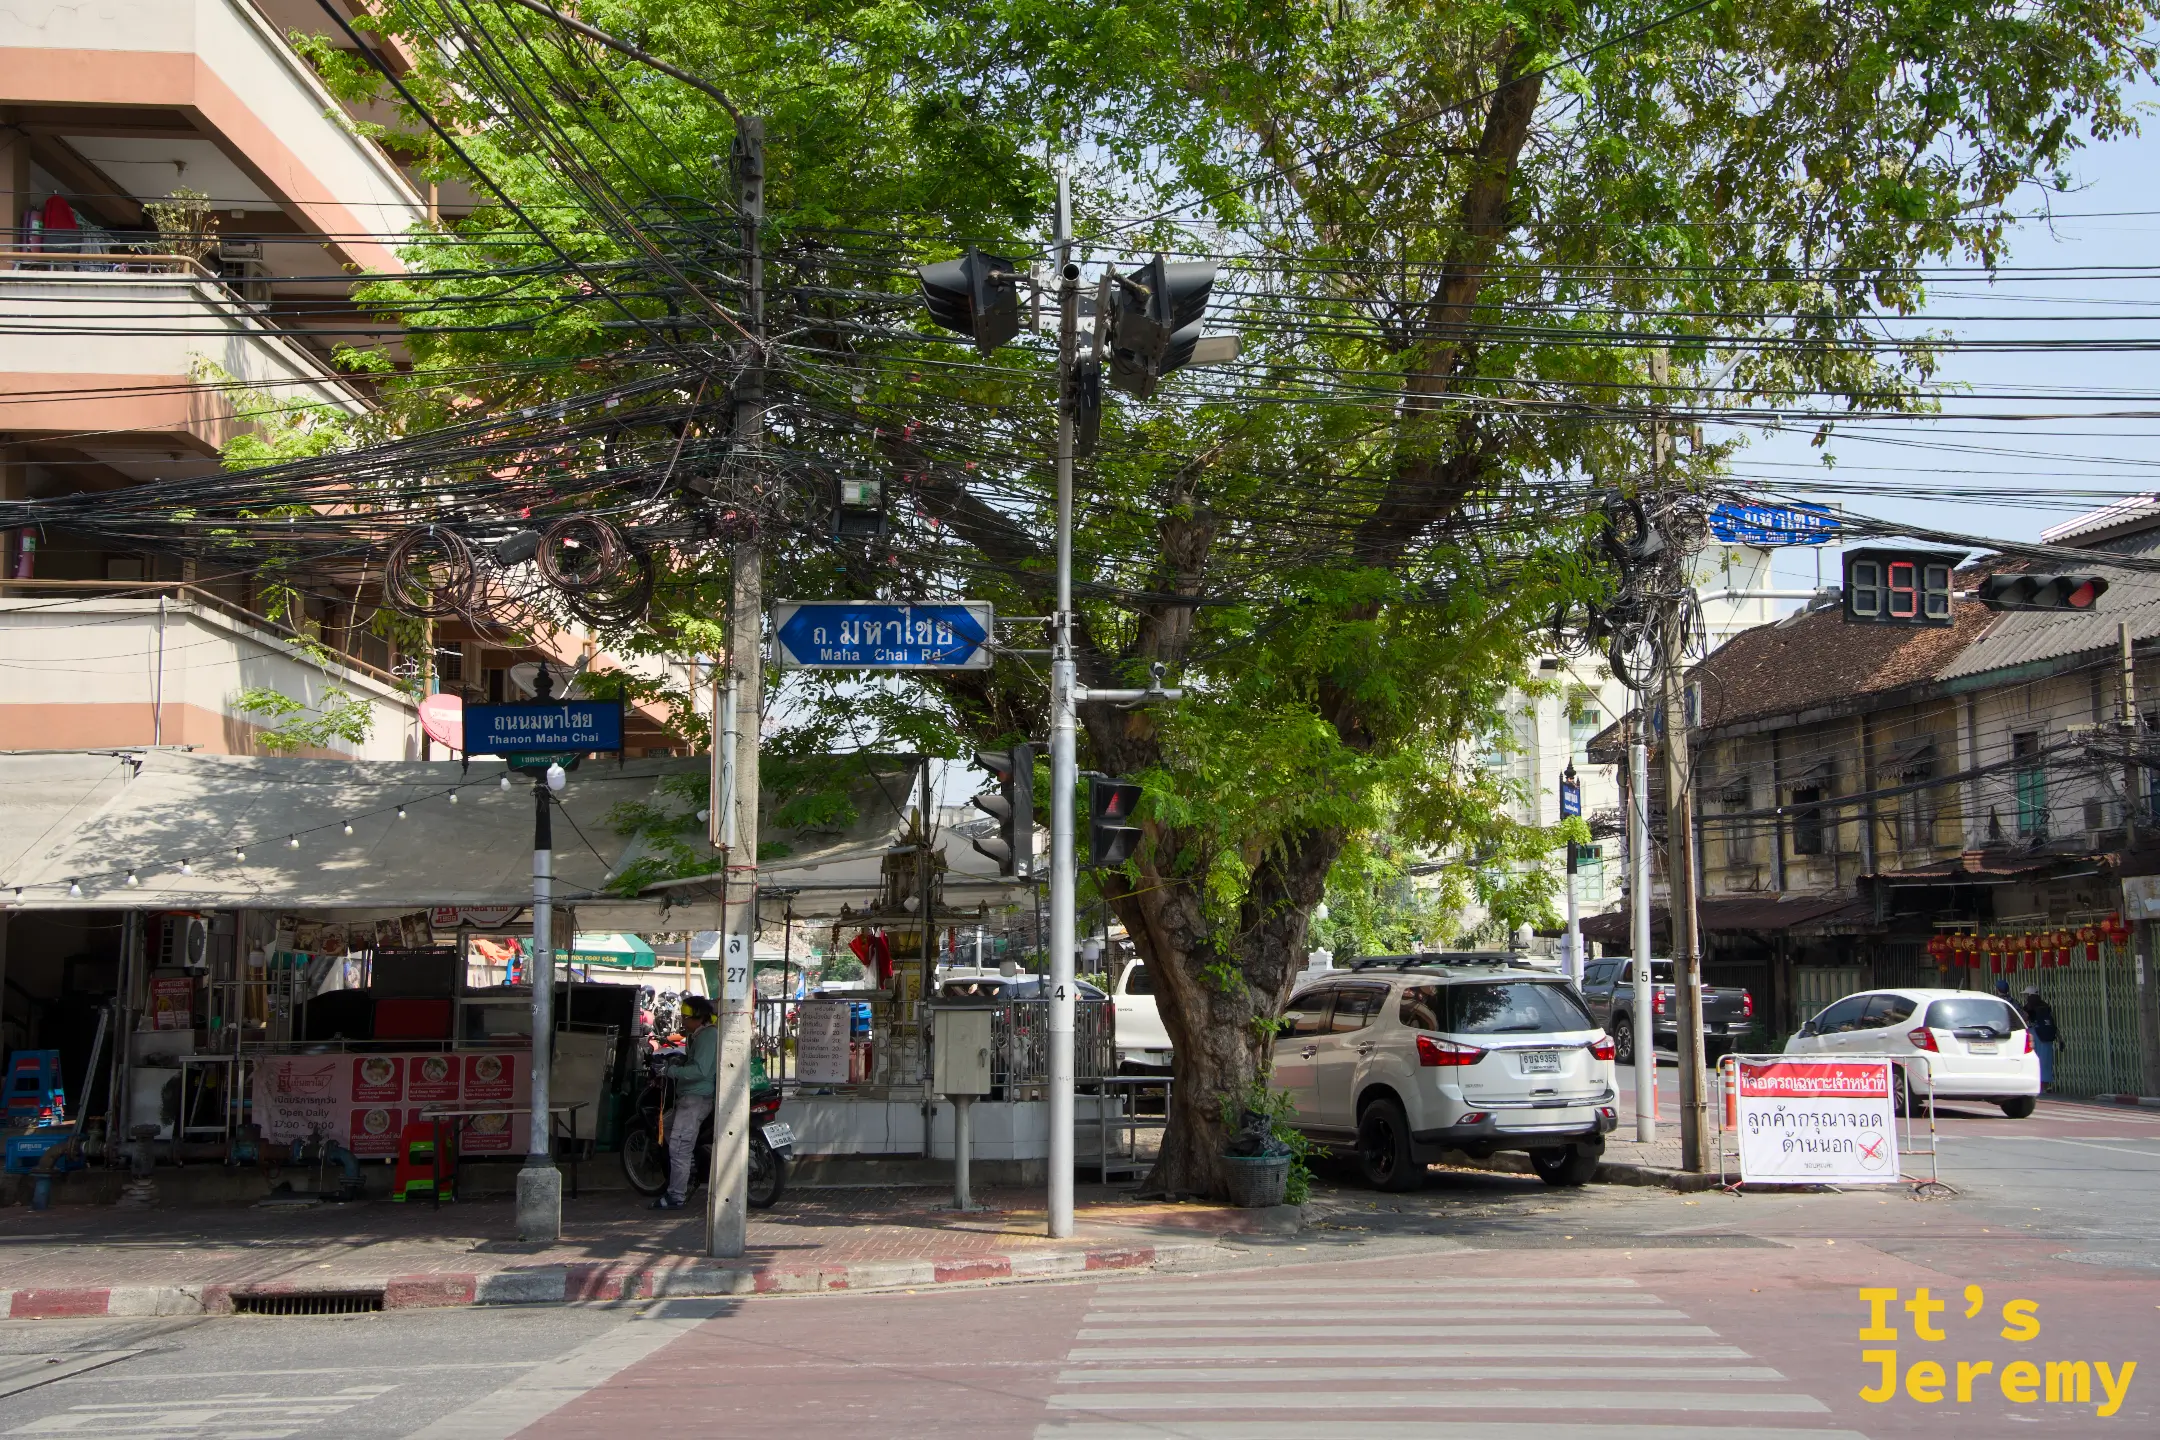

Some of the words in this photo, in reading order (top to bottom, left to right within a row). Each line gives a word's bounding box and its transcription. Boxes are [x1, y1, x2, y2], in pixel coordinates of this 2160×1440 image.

[813, 626, 833, 645] ถ.
[839, 606, 953, 645] มหาไชย
[820, 648, 860, 661] Maha
[875, 648, 908, 661] Chai
[921, 649, 945, 661] Rd.
[494, 705, 593, 731] ถนนมหาไชย
[488, 734, 532, 745] Thanon
[536, 733, 568, 743] Maha
[572, 732, 599, 742] Chai
[727, 967, 746, 983] 27
[1641, 971, 1648, 982] 5
[1054, 985, 1066, 1001] 4
[1741, 1069, 1887, 1090] ที่จอดรถเฉพาะเจ้าหน้าที่
[274, 1096, 337, 1106] เปิดบริการทุกวัน
[279, 1108, 304, 1117] Open
[306, 1109, 330, 1118] Daily
[1748, 1104, 1883, 1135] ลูกค้ากรุณาจอด
[274, 1120, 300, 1129] 17:00
[1782, 1131, 1854, 1153] ด้านนอก
